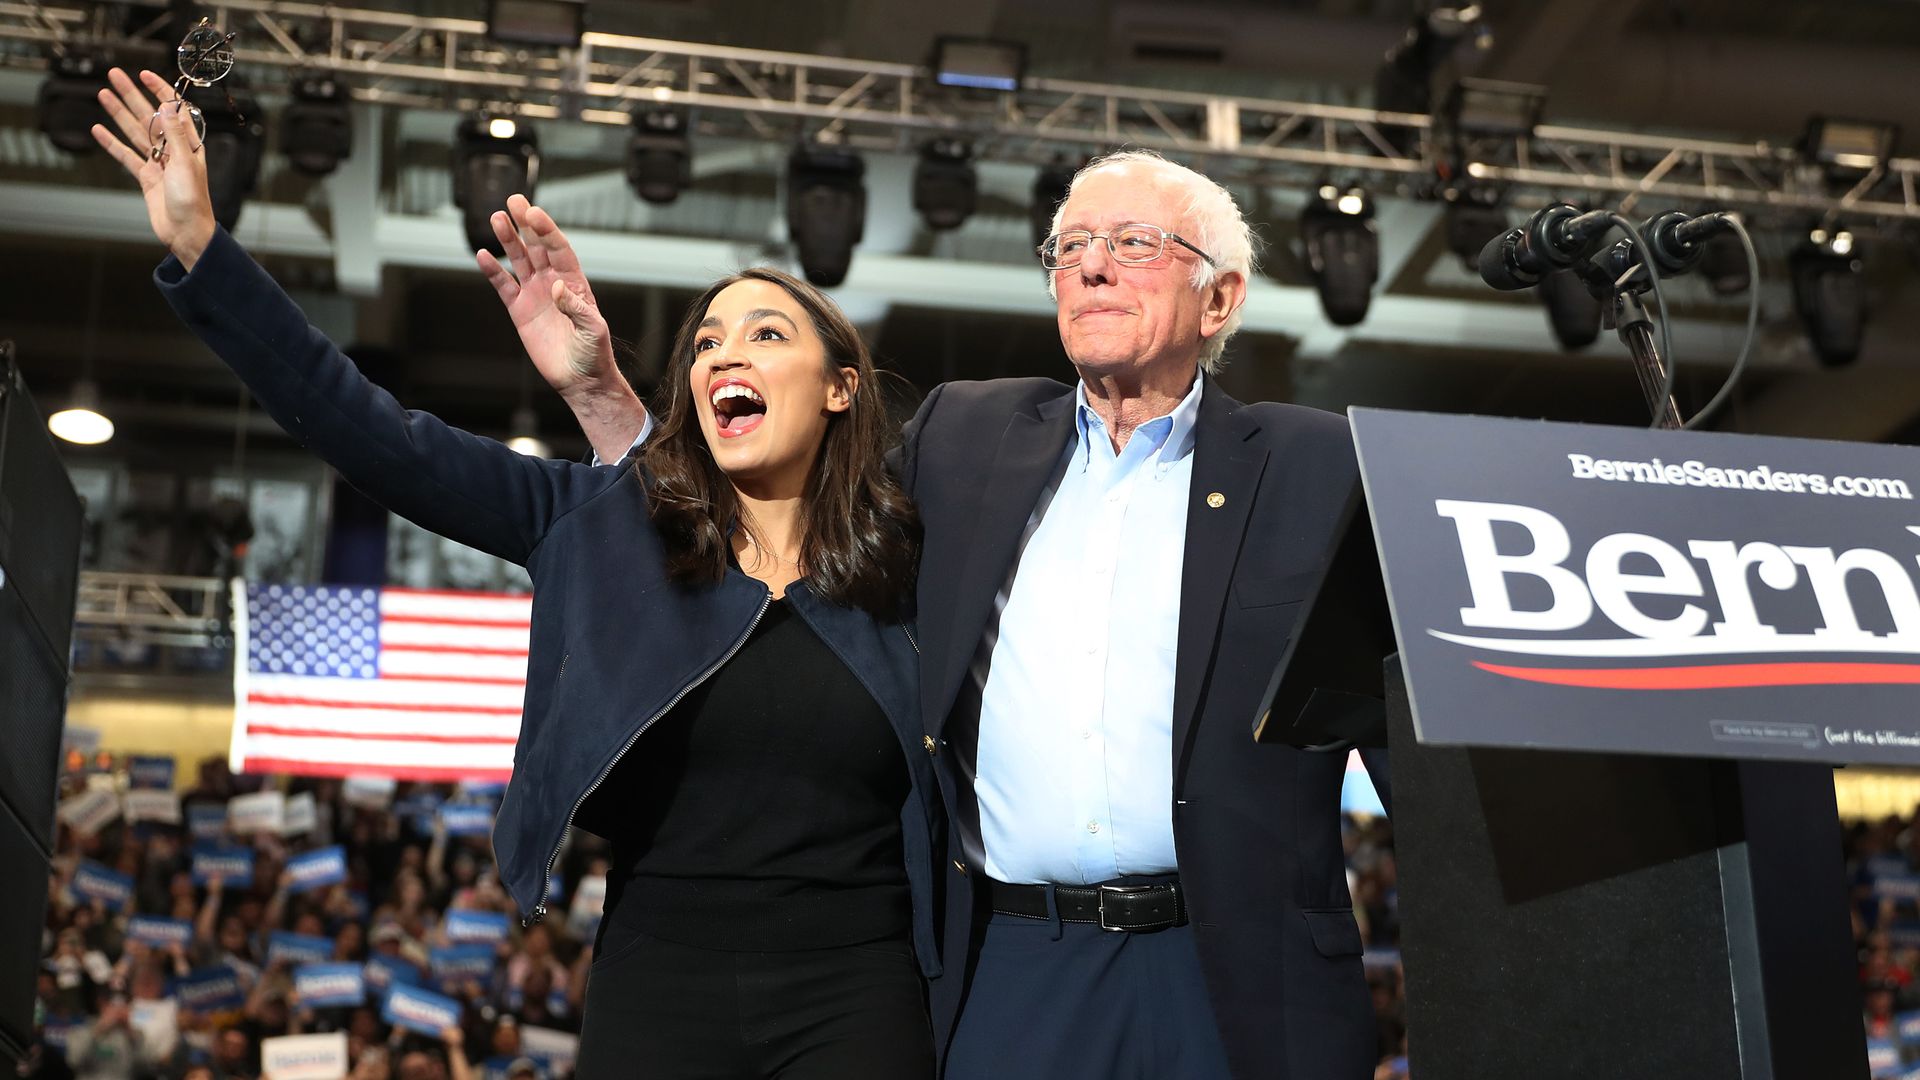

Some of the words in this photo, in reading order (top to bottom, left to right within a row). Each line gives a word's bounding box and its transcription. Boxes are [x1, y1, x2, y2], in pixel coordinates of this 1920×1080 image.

[1568, 453, 1913, 499] BernieSanders.com
[1435, 499, 1920, 638] Bern
[1853, 730, 1874, 745] the
